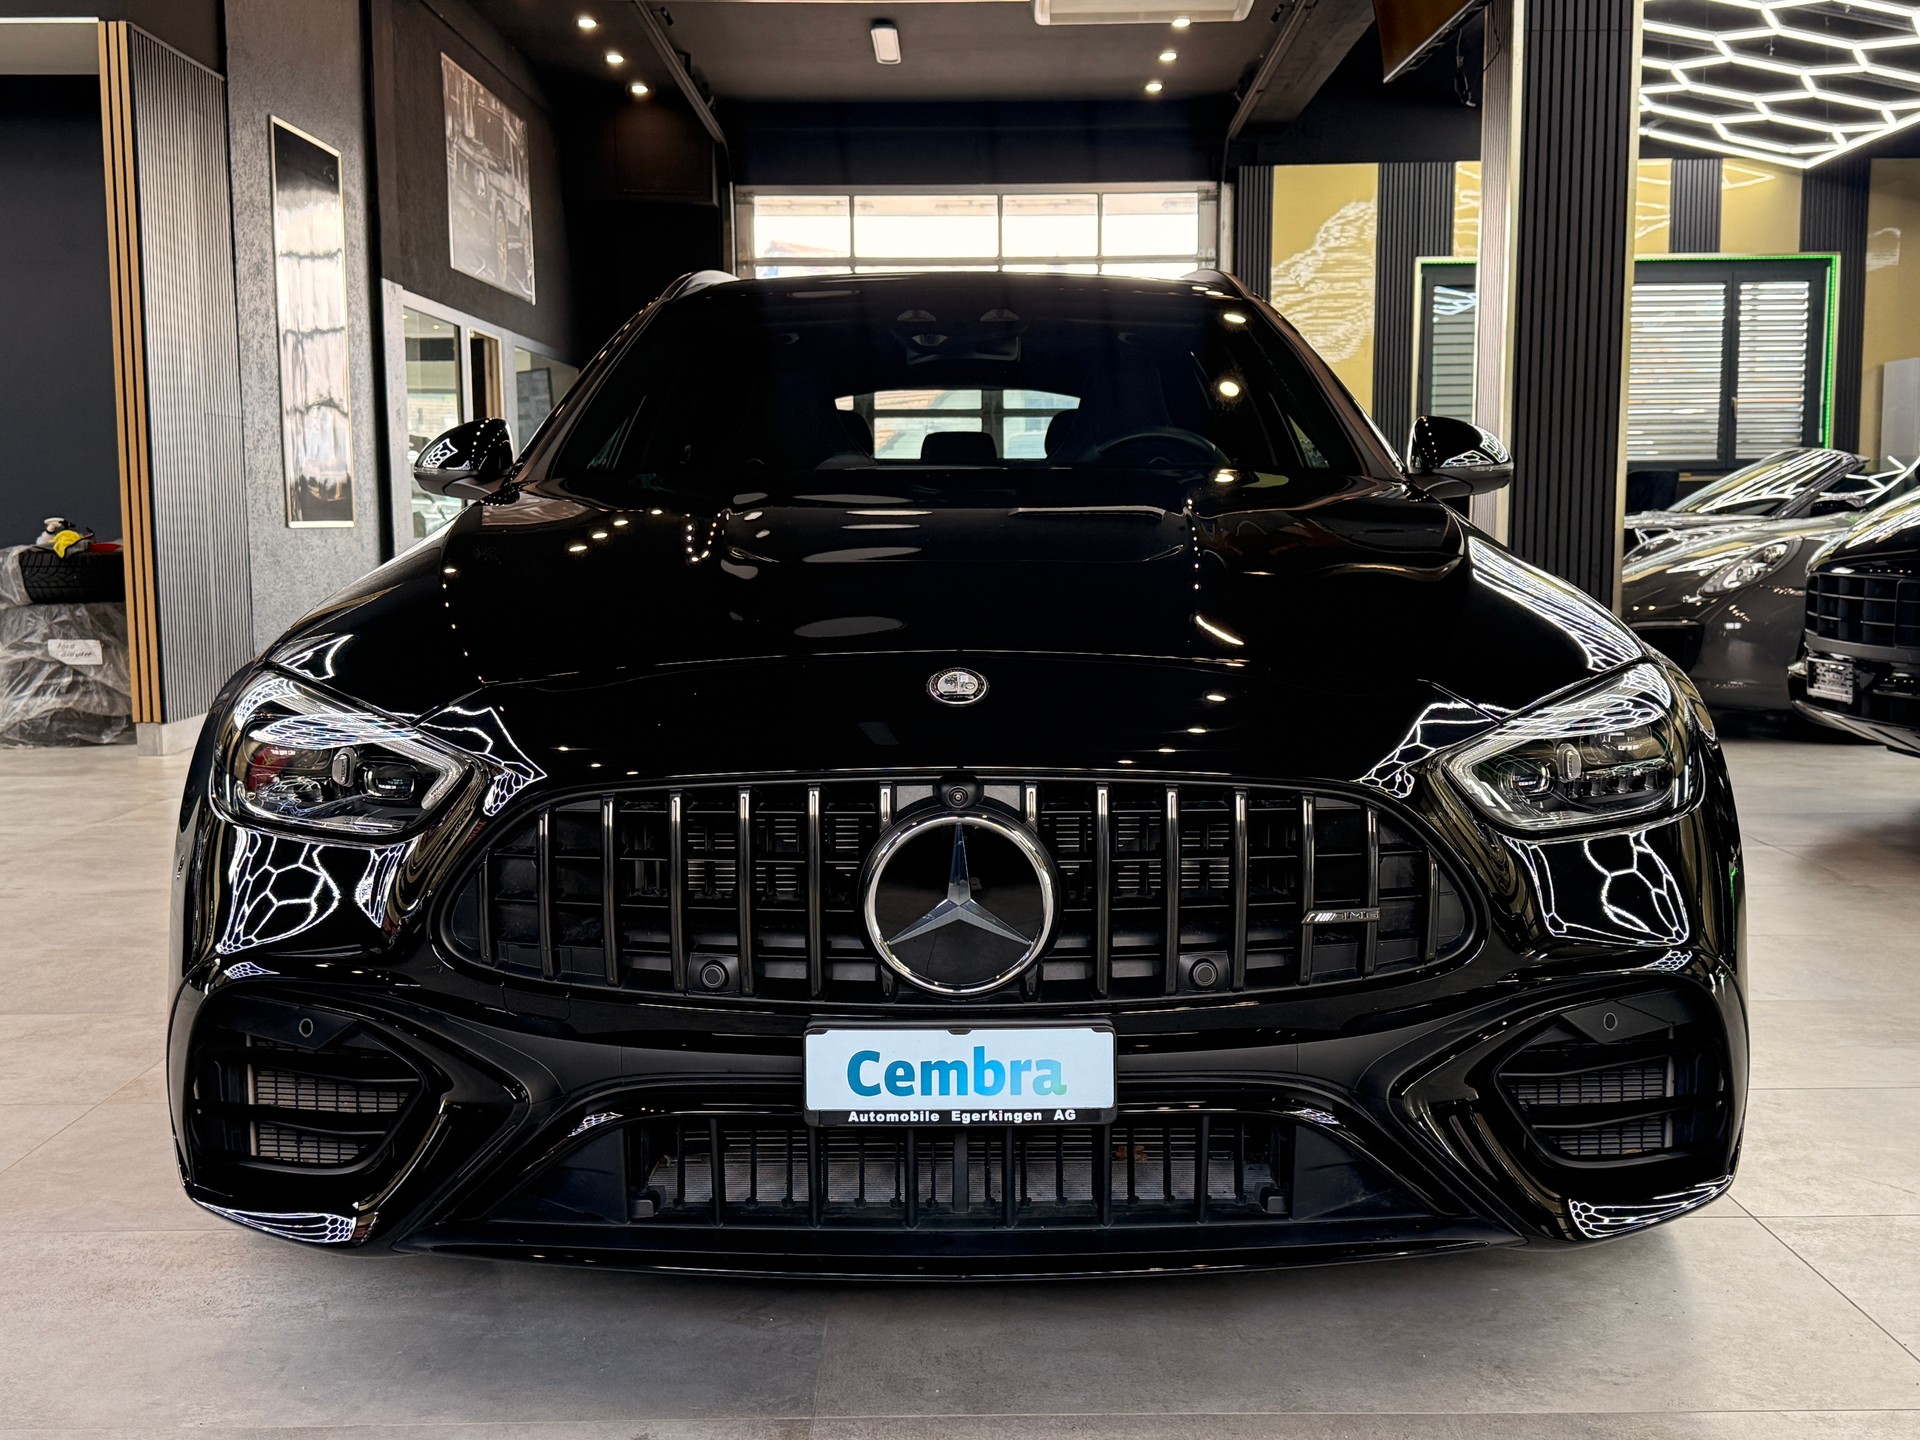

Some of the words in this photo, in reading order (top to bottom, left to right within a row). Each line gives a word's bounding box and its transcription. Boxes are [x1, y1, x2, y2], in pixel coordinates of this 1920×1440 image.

[847, 1045, 1068, 1097] Cembra
[848, 1110, 940, 1123] Automobile
[951, 1110, 1042, 1124] Egerkingen
[1053, 1109, 1077, 1121] AG
